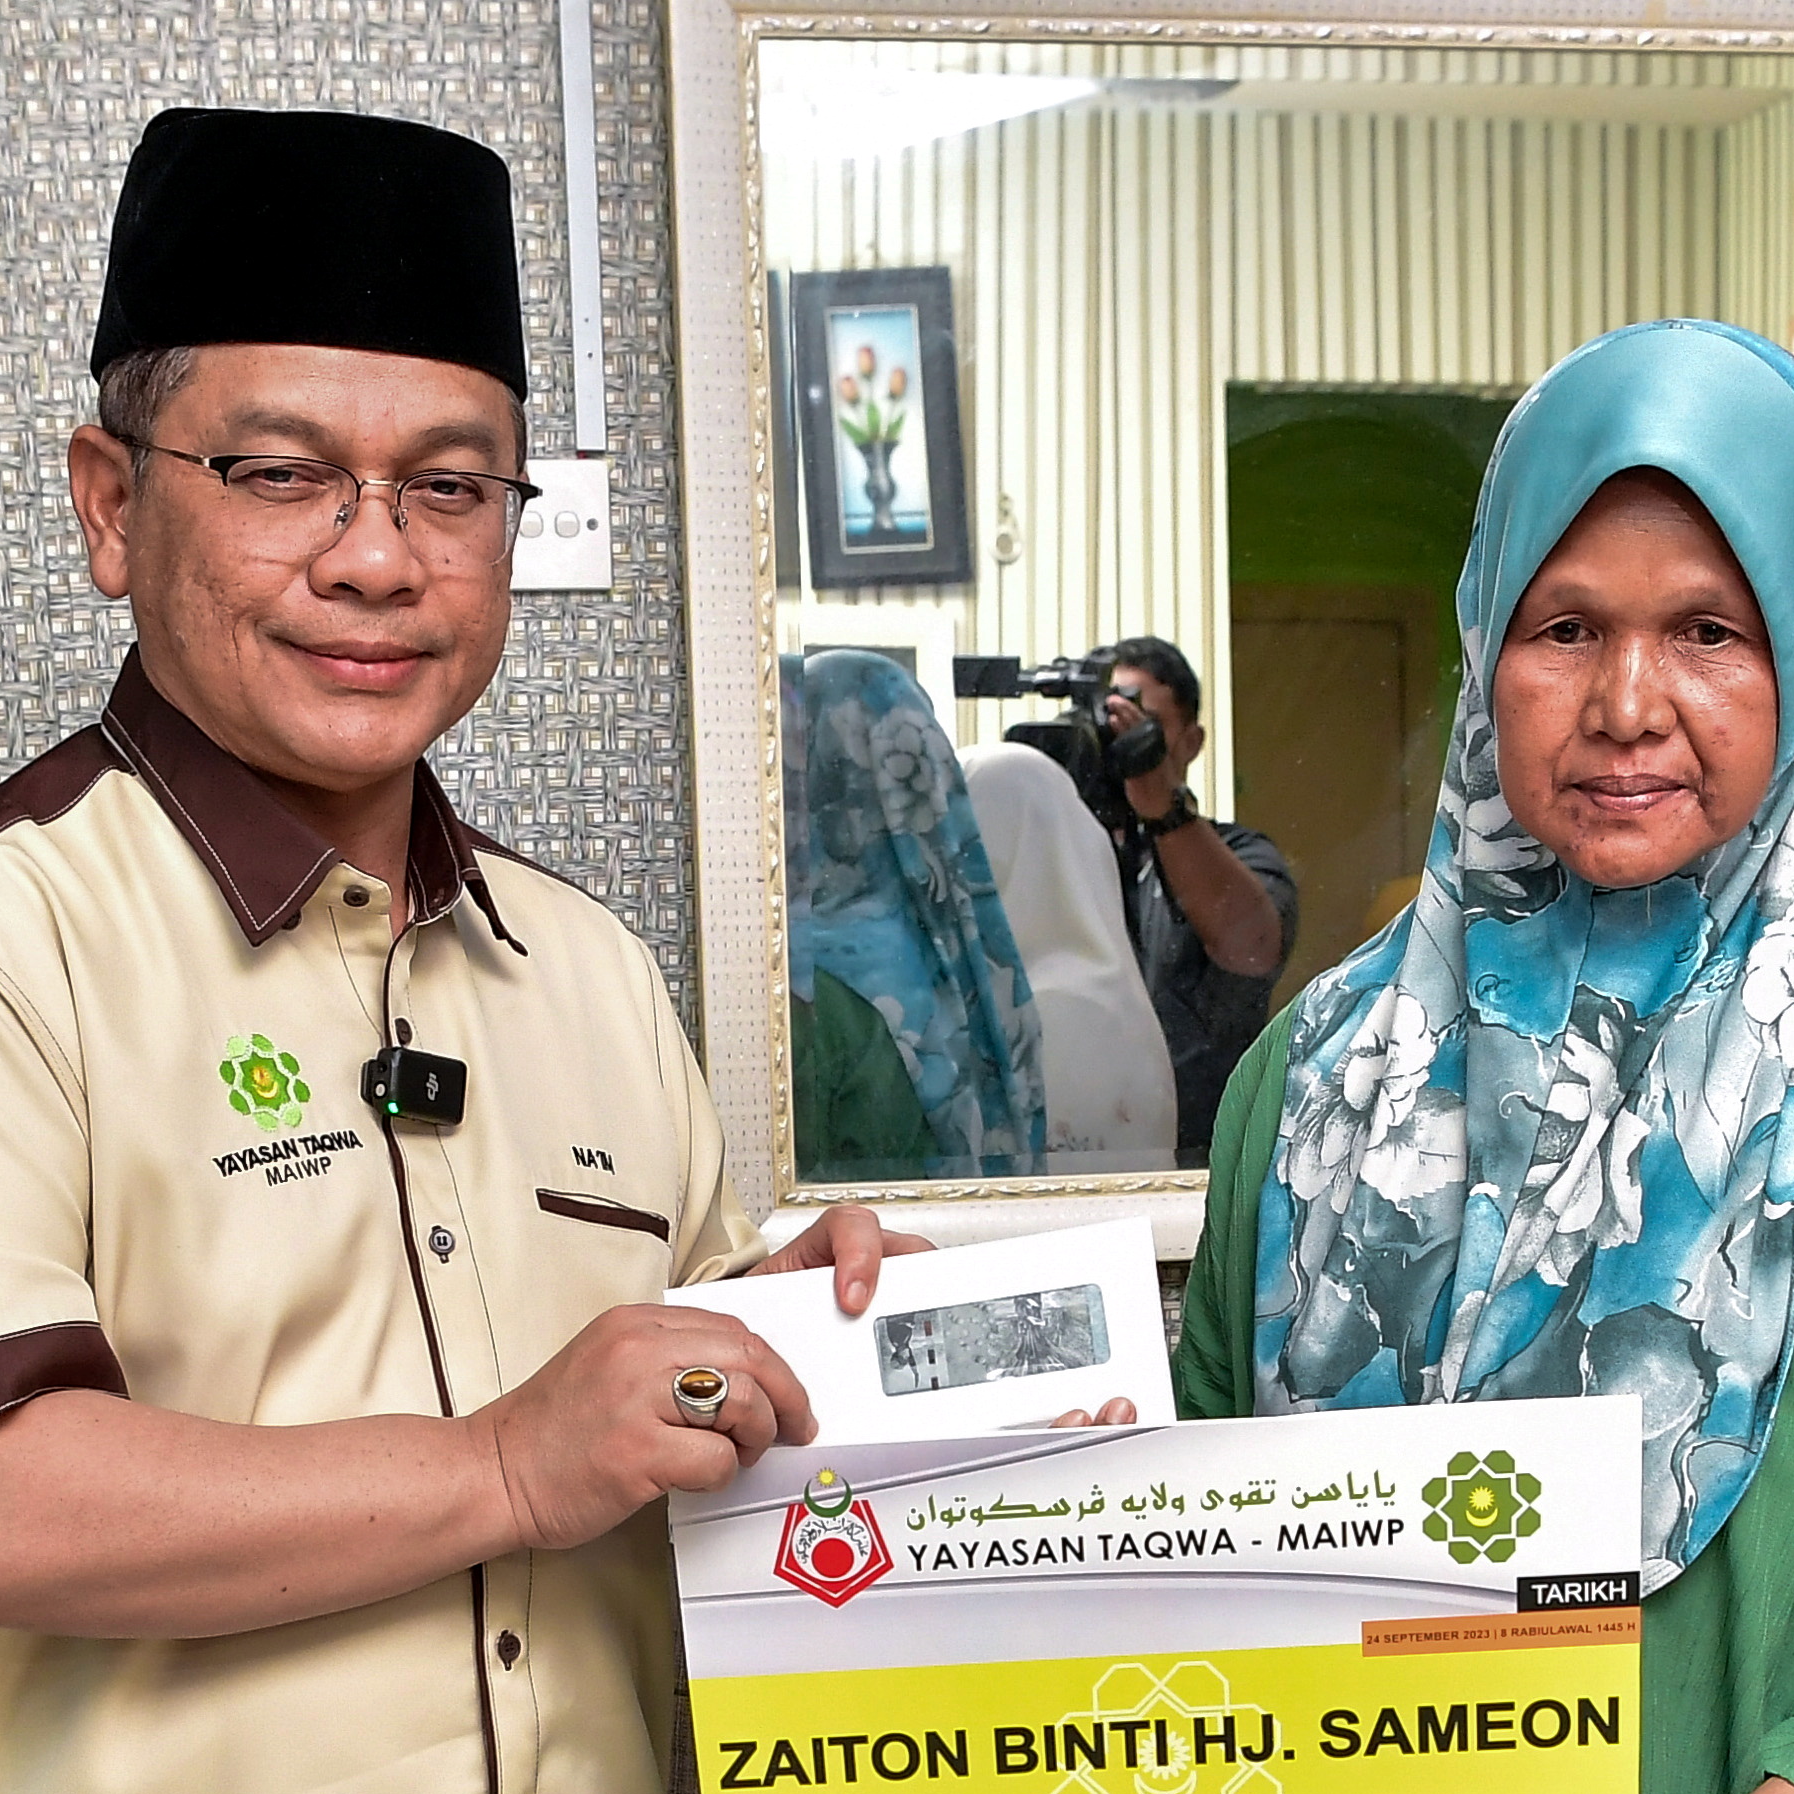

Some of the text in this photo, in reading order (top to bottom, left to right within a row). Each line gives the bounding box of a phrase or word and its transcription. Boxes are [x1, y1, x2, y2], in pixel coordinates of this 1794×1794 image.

[212, 1130, 364, 1177] YAYASAN TAQWA
[265, 1156, 332, 1186] MAIWP
[906, 1534, 1086, 1572] YAYASAN
[1097, 1528, 1238, 1562] TAQWA
[1277, 1518, 1405, 1552] MAIWP
[1531, 1580, 1627, 1605] TARIKH
[1366, 1635, 1380, 1645] 24
[1384, 1631, 1460, 1644] SEPTEMBER
[1463, 1629, 1491, 1640] 2023
[1500, 1628, 1507, 1638] 8
[1511, 1624, 1593, 1636] RABIULAWAL
[1597, 1622, 1623, 1633] 1445
[1627, 1622, 1636, 1632] H
[718, 1695, 1621, 1790] ZAITON BINTI HJ. SAMEON
